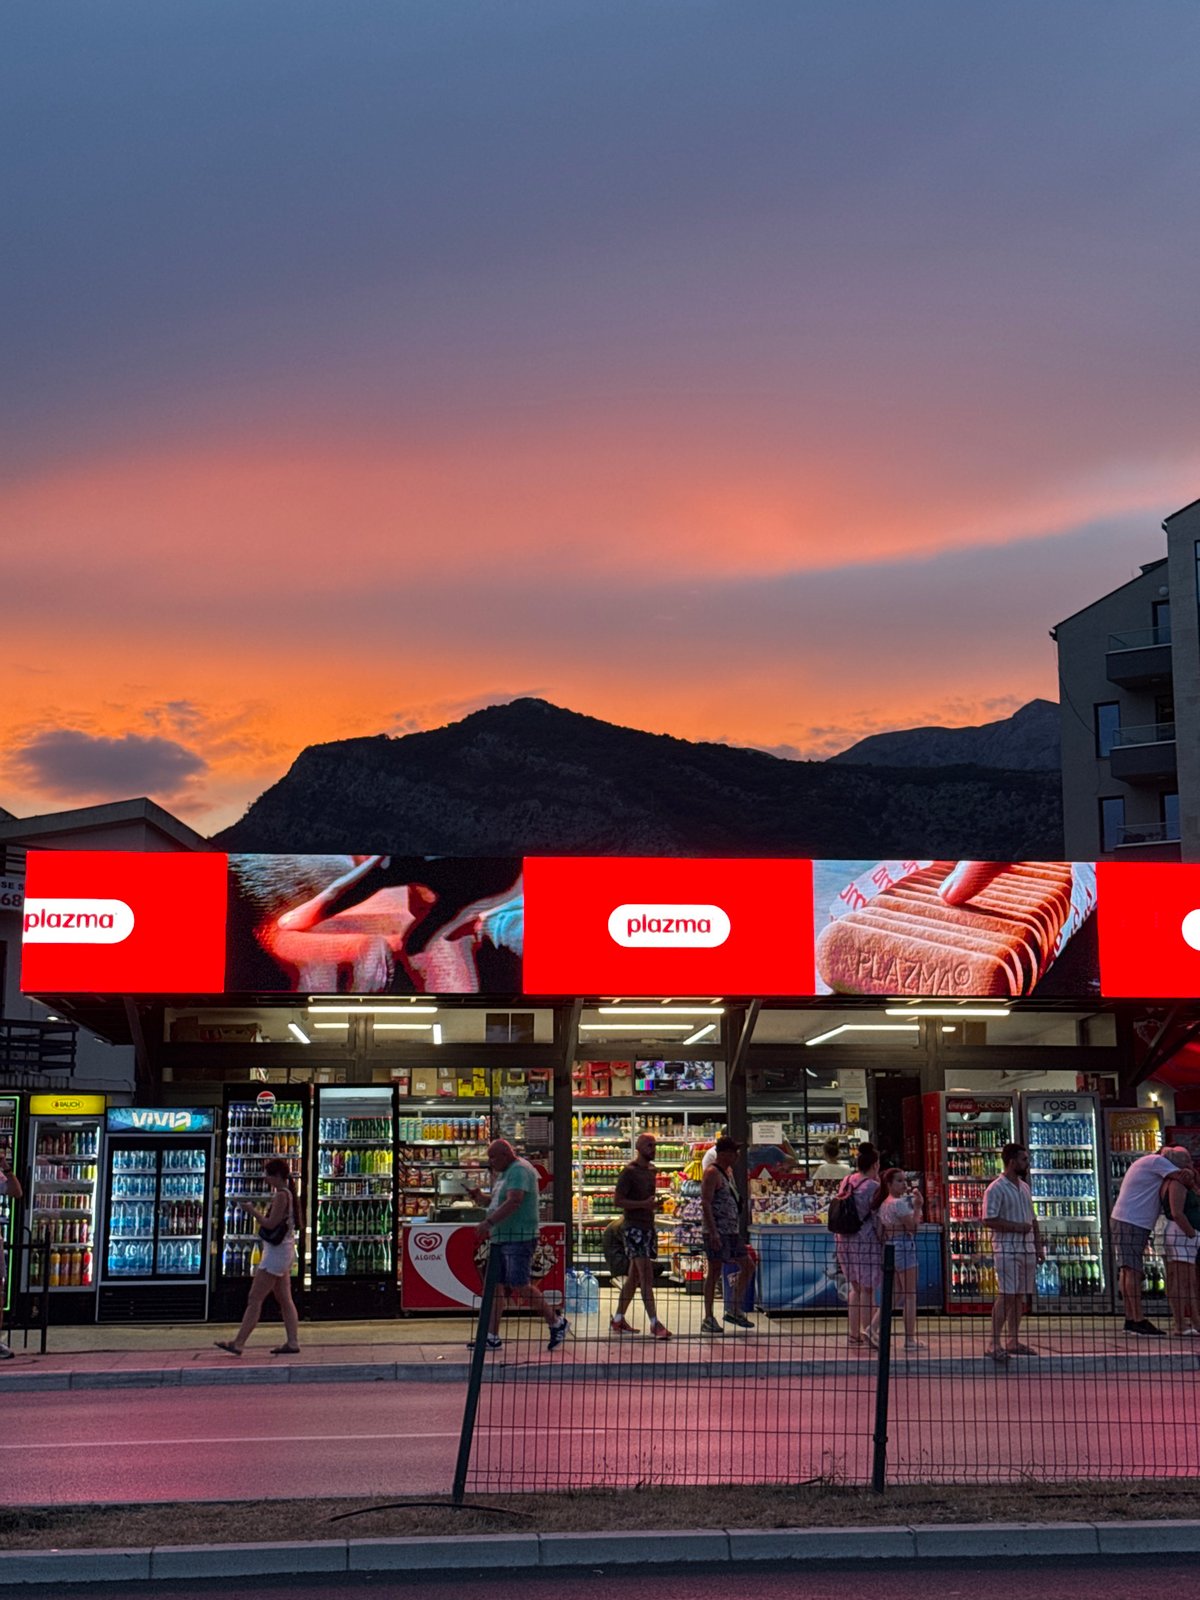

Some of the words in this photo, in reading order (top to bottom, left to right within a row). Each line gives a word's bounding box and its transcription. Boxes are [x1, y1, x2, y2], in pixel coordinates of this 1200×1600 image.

[24, 909, 114, 932] plazma
[628, 914, 711, 938] plazma
[1043, 1100, 1077, 1111] rosa
